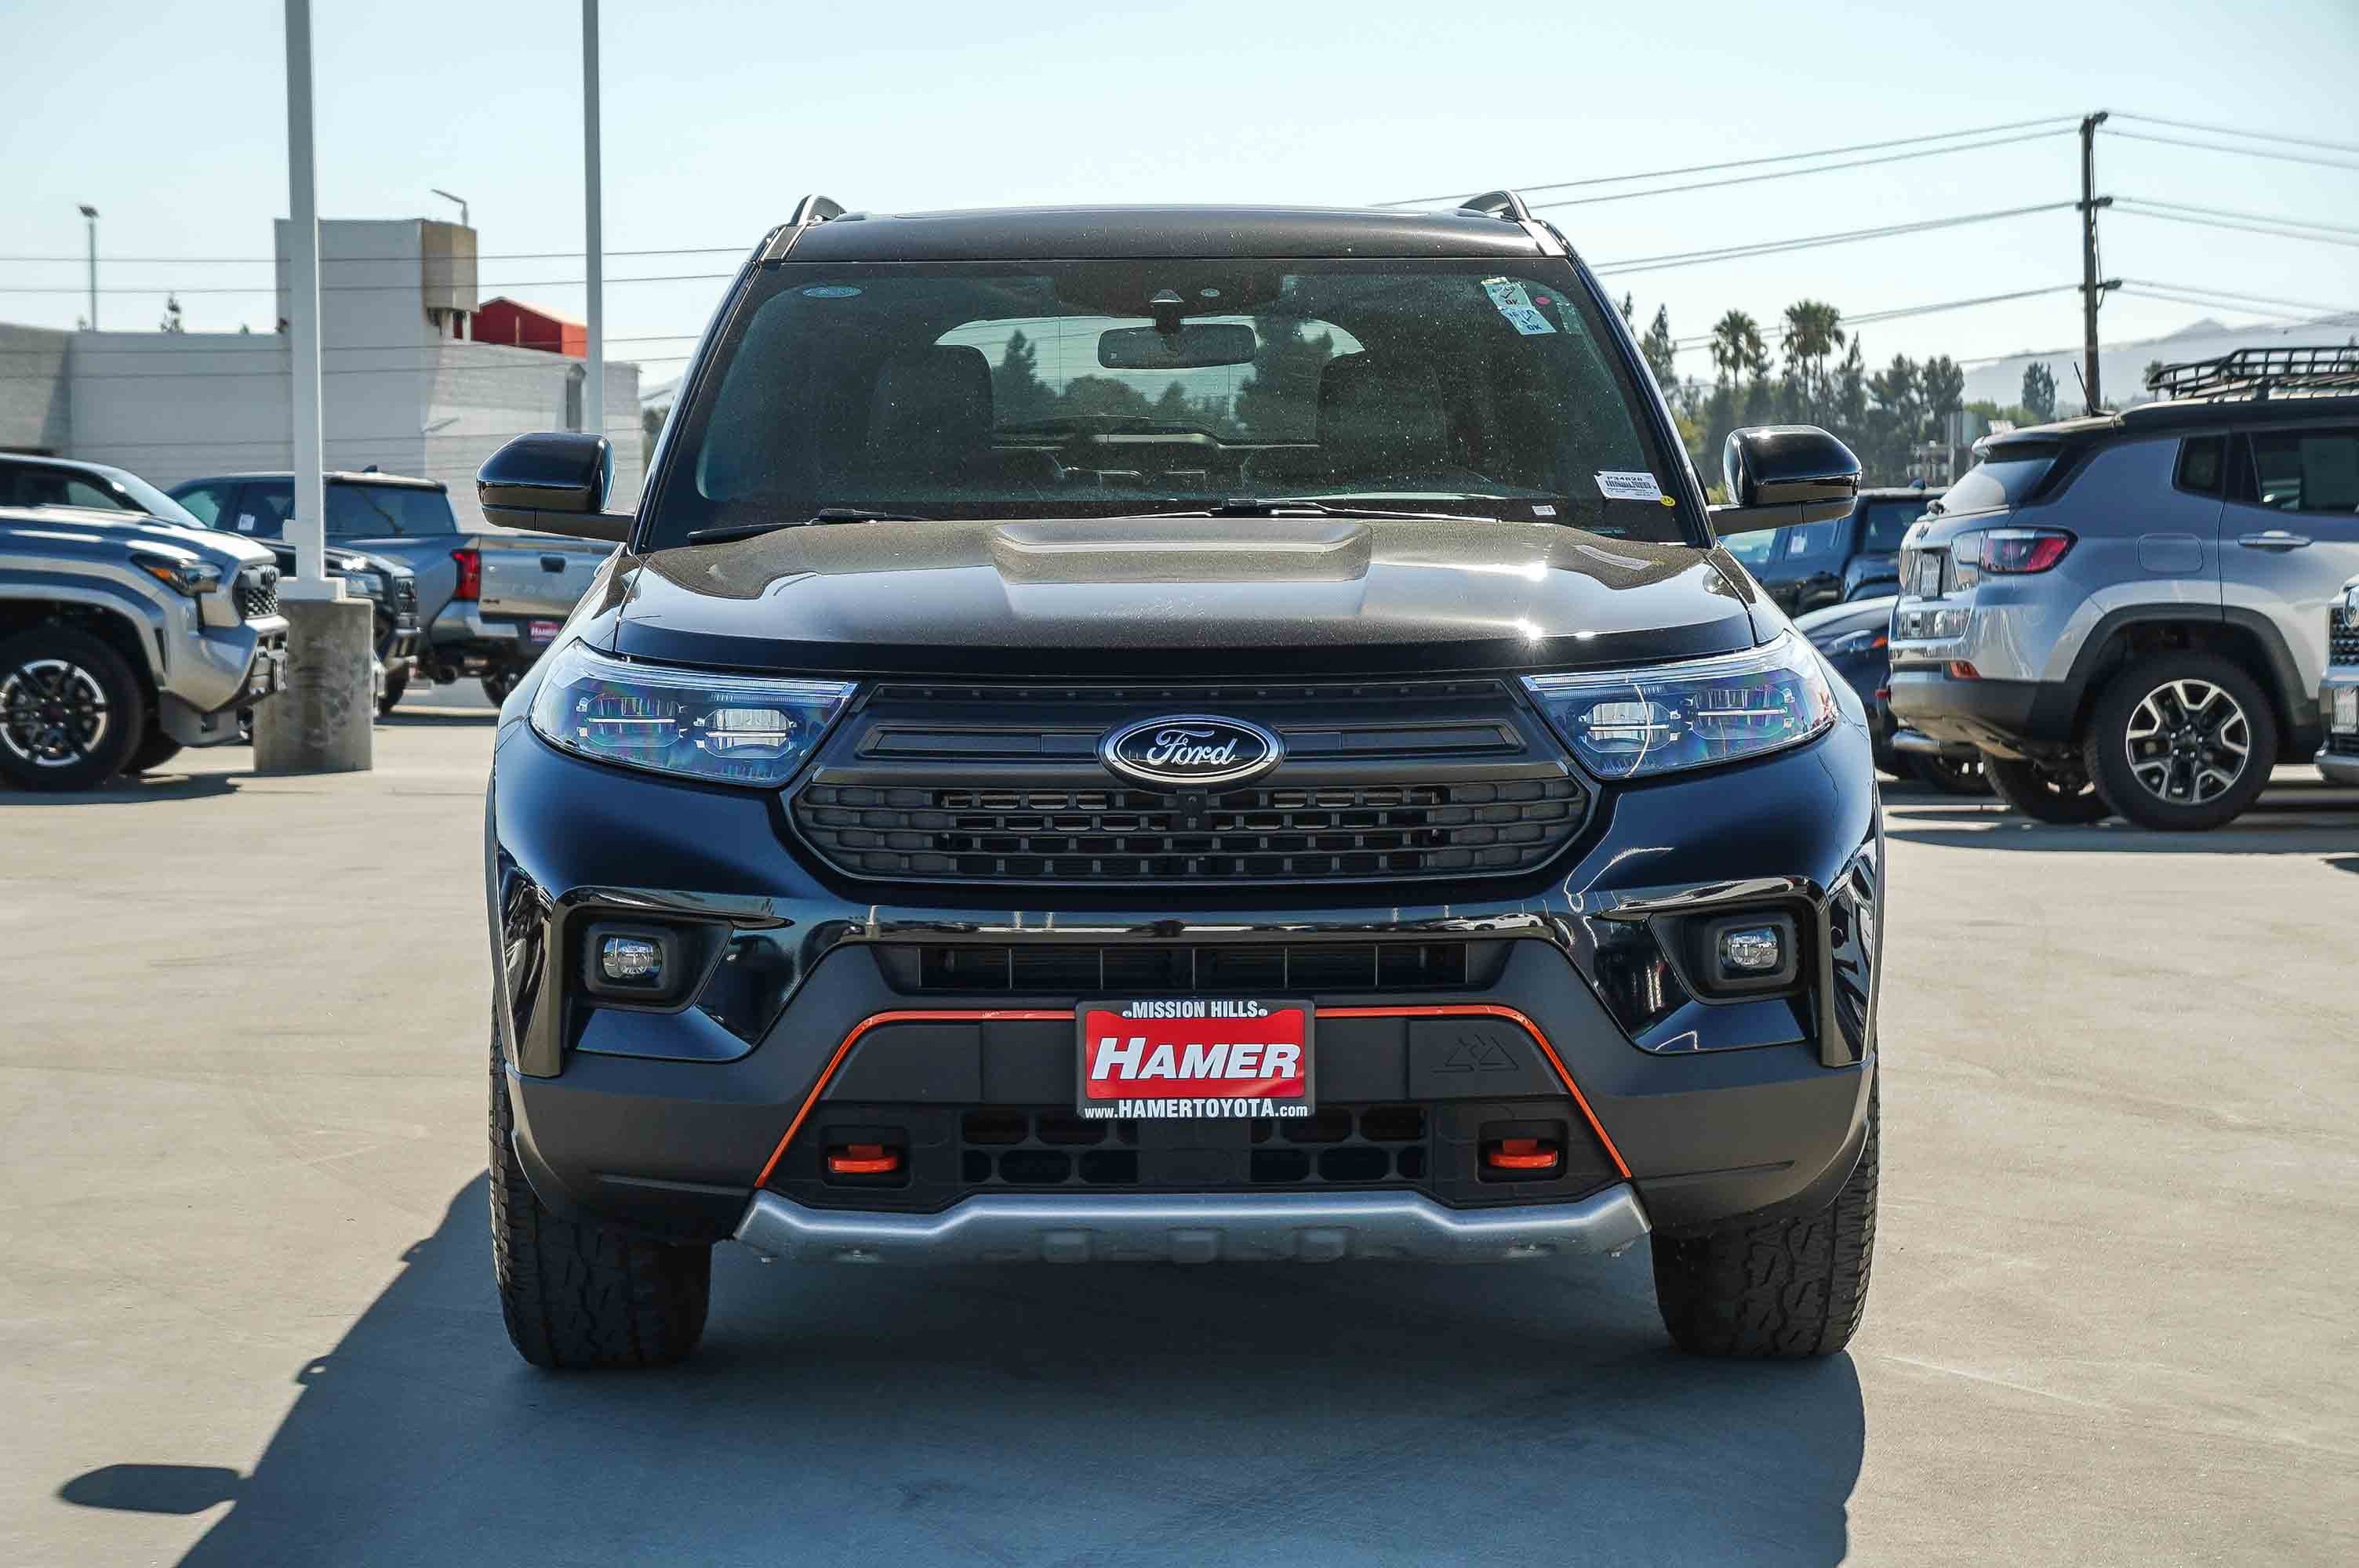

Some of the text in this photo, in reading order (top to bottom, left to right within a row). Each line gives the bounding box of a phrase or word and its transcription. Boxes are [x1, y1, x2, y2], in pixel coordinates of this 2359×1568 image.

[1147, 730, 1238, 765] Ford
[1132, 1000, 1258, 1018] MISSION HILLS
[1091, 1036, 1301, 1080] HAMER
[1084, 1098, 1308, 1119] www.HAMERTOYOTA.com
